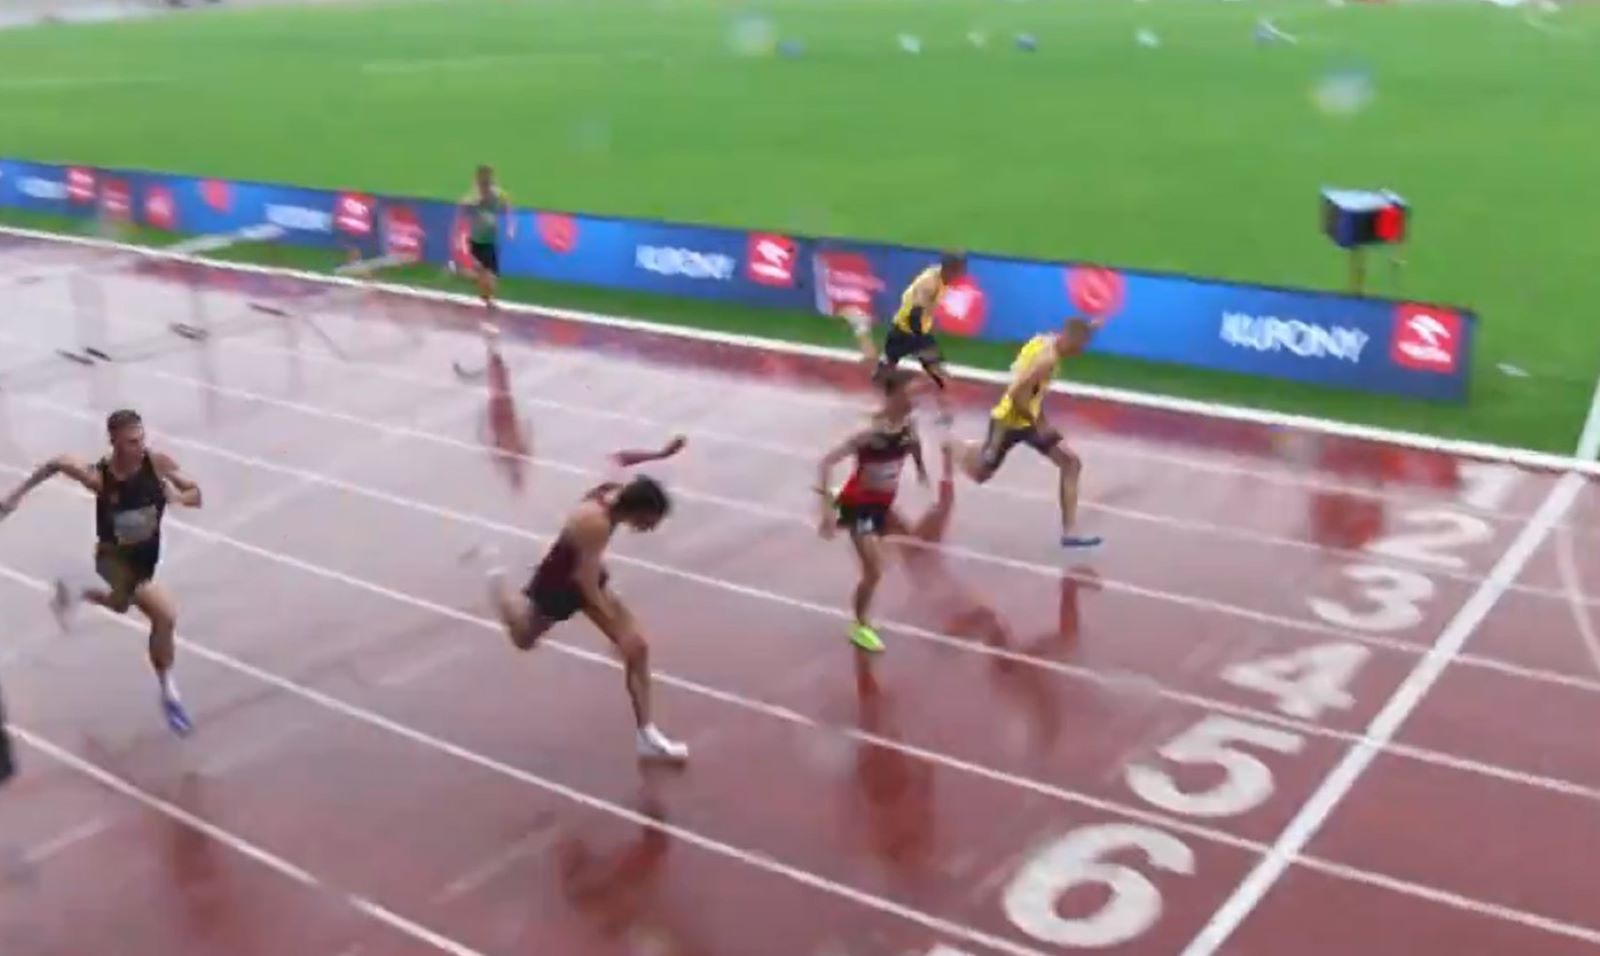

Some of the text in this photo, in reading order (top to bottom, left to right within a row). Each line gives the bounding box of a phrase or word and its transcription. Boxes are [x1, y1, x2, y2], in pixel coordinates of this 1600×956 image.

[1363, 510, 1491, 568] 2
[1308, 565, 1435, 631] 3
[1220, 643, 1371, 717] 4
[1126, 714, 1305, 817] 5
[1003, 824, 1195, 947] 6
